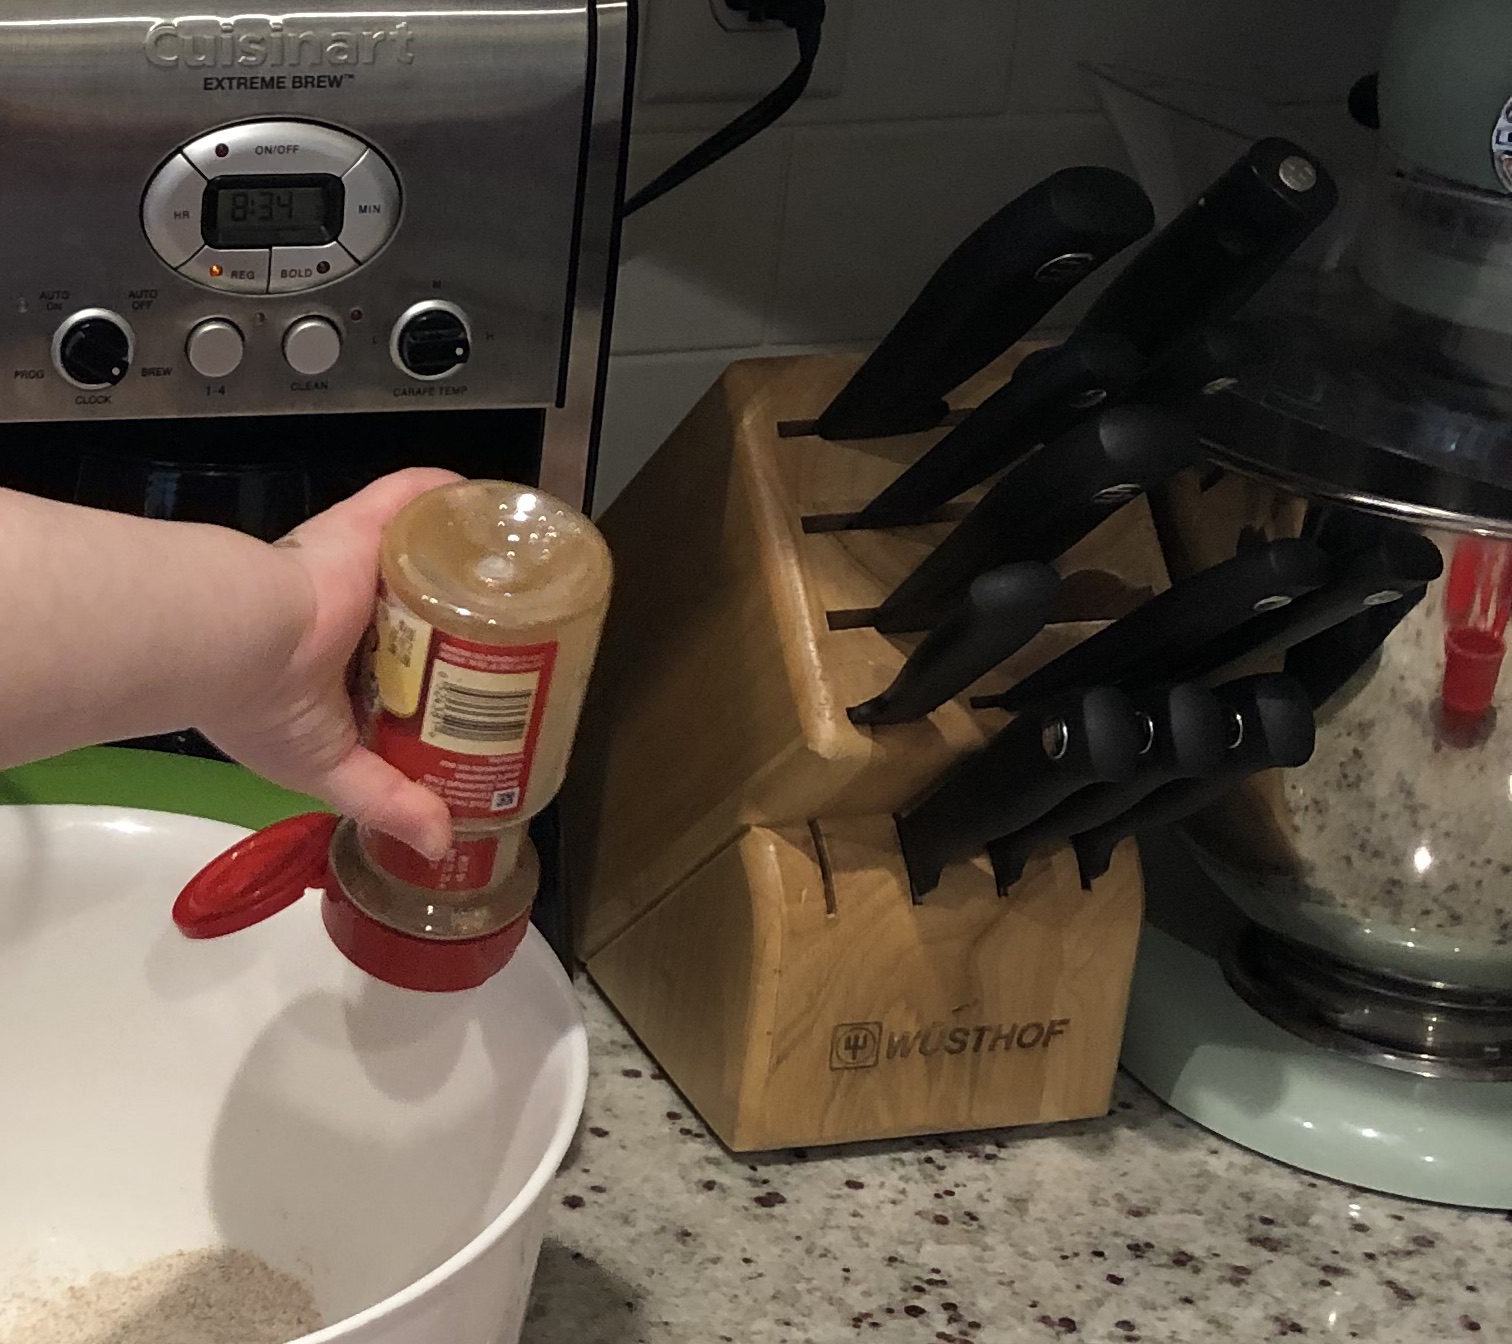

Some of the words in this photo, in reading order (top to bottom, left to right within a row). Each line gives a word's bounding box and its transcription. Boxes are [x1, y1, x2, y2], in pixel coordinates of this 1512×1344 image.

[144, 20, 415, 67] Cuisinart
[203, 76, 286, 91] EXTREME
[255, 145, 300, 155] ON/OFF
[231, 192, 294, 222] 8:34
[358, 204, 381, 215] MIN
[173, 210, 190, 220] HR
[230, 269, 255, 280] REG
[280, 268, 313, 279] BOLD
[39, 290, 70, 301] AUTO
[128, 289, 158, 300] AUTO
[14, 369, 44, 380] PROG
[141, 367, 173, 377] BREW
[206, 385, 226, 396] 1-4
[291, 381, 329, 392] CLEAN
[393, 387, 435, 398] CARAFE
[439, 385, 468, 396] TEMP
[75, 395, 112, 406] CLOCK
